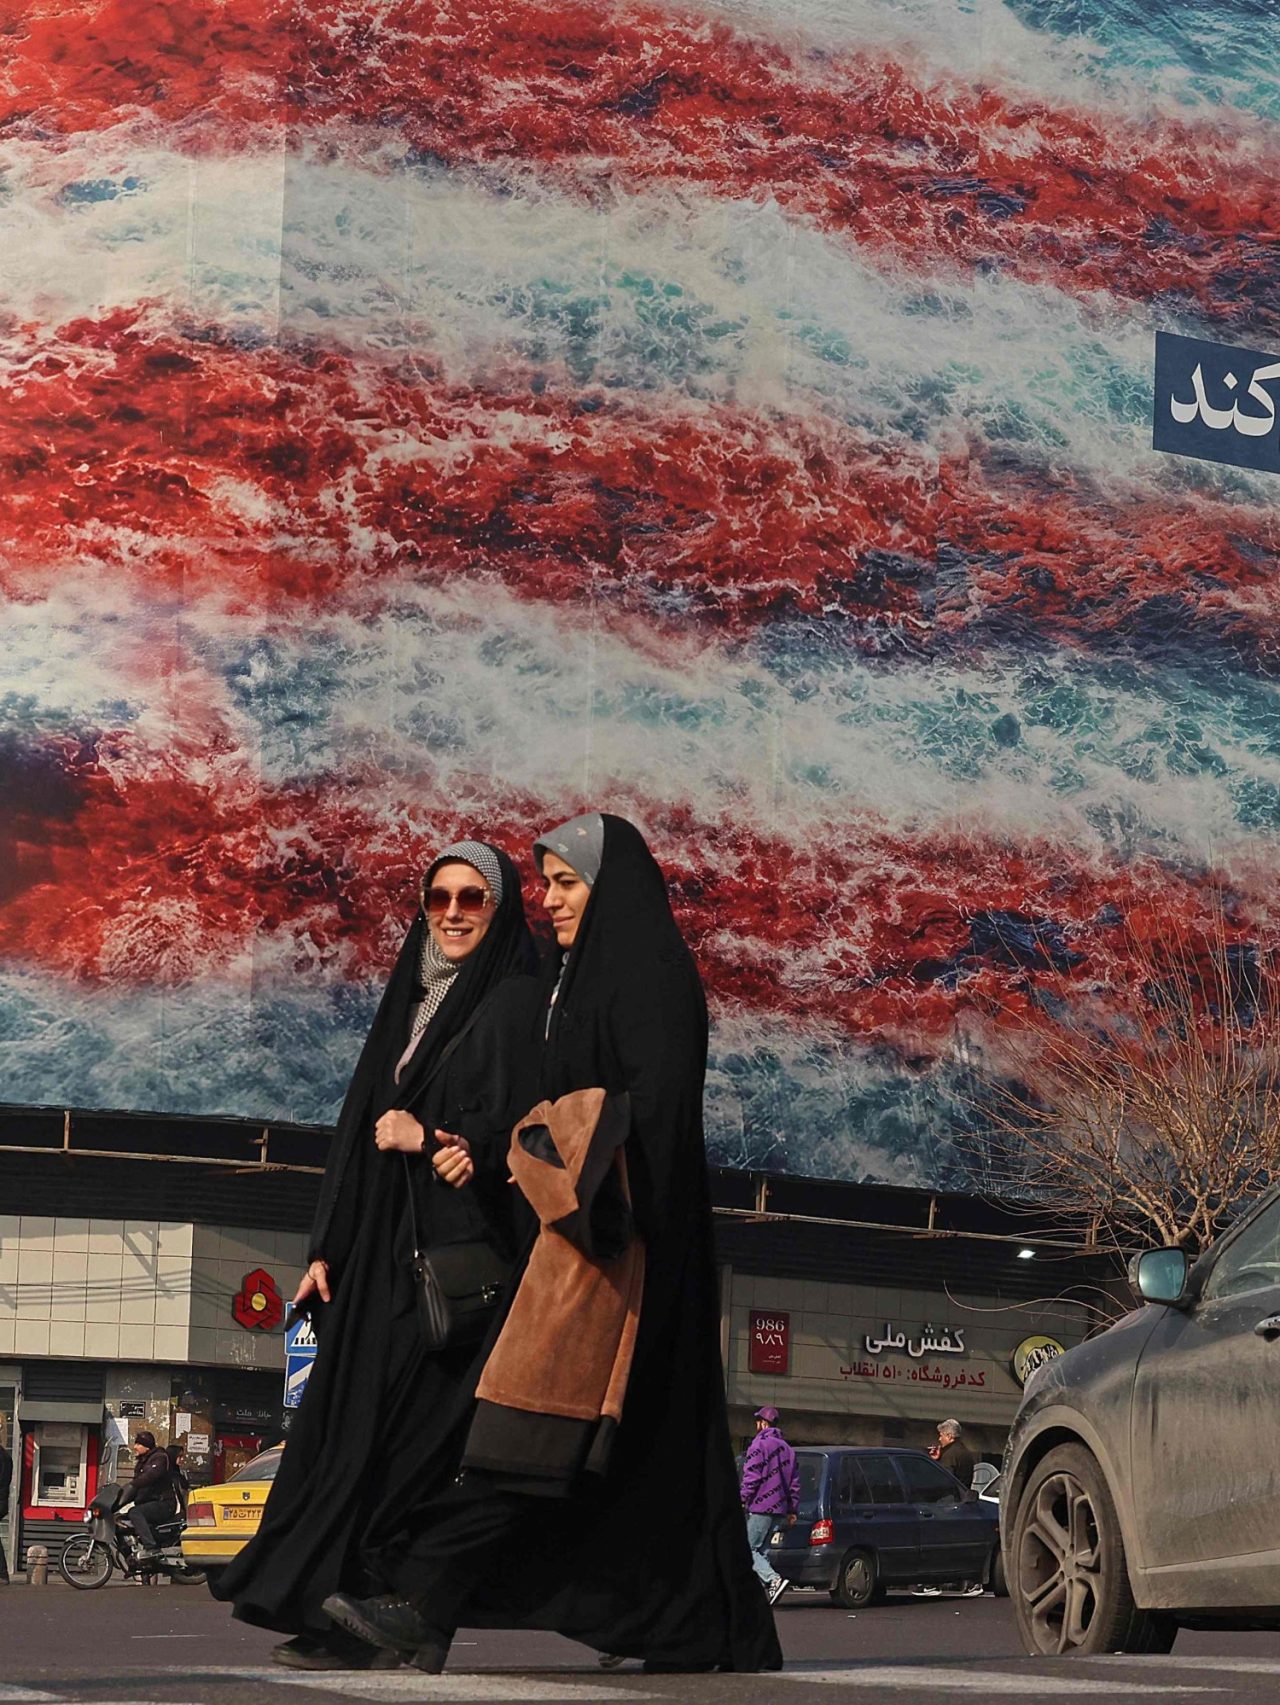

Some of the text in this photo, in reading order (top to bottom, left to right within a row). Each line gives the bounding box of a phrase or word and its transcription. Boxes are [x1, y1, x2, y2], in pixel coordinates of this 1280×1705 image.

[1170, 362, 1280, 437] کند
[756, 1318, 785, 1332] 986
[865, 1323, 965, 1358] کفش ملی
[839, 1361, 879, 1378] انقلاب
